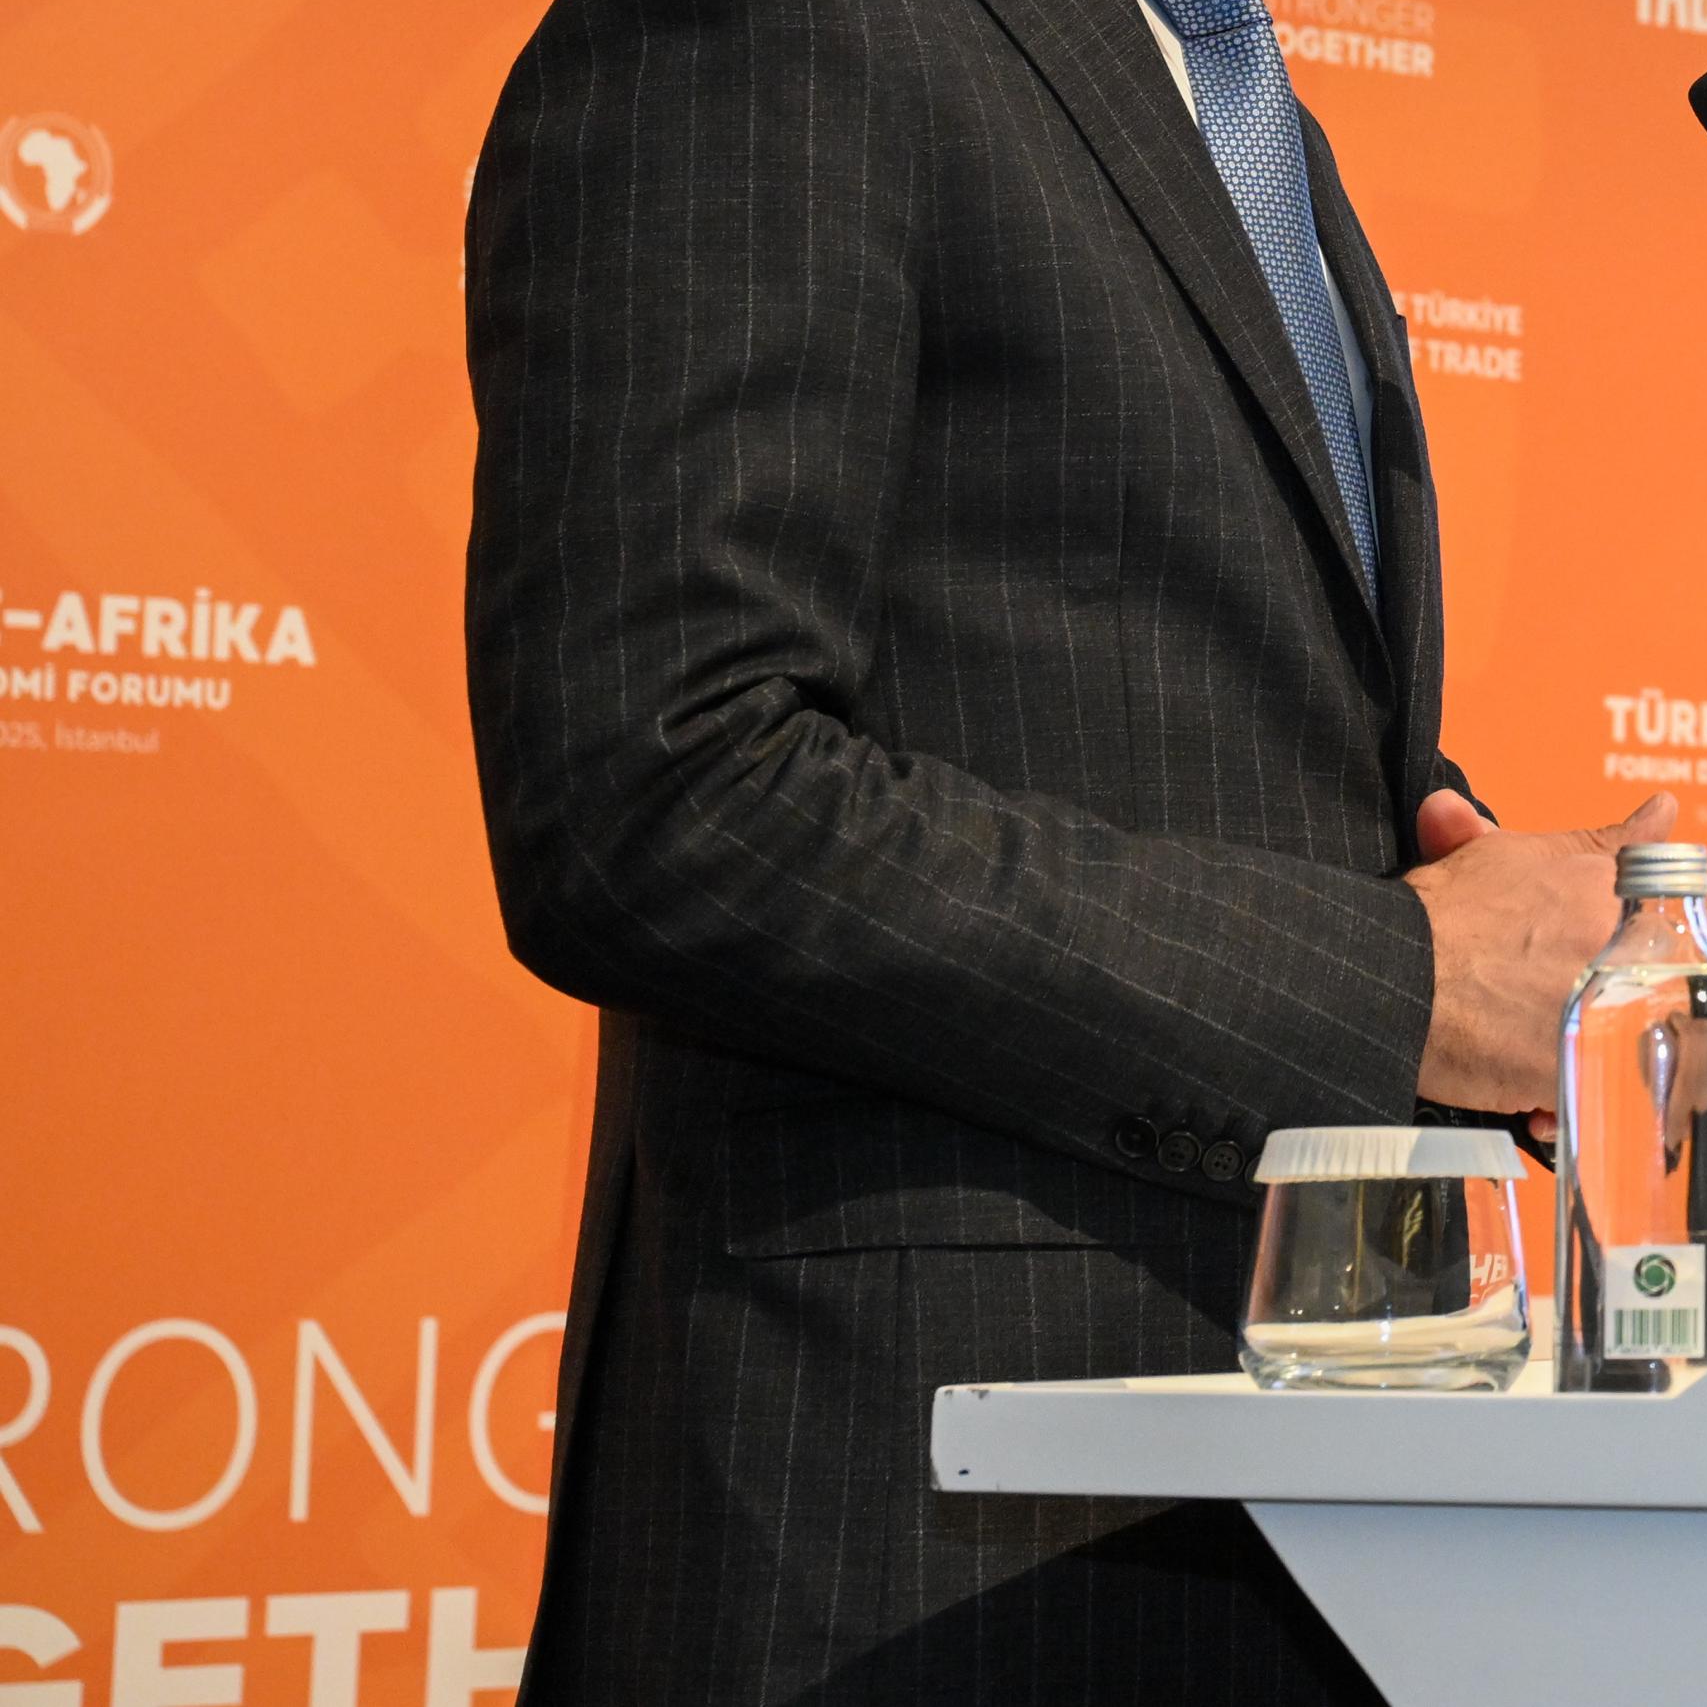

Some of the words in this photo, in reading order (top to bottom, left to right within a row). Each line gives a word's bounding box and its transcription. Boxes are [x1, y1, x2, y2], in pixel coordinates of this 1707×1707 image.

[1411, 289, 1523, 337] TÜRKİYE
[1425, 339, 1523, 382] TRADE
[66, 668, 232, 712] FORUMU
[1604, 752, 1692, 785] FORUM
